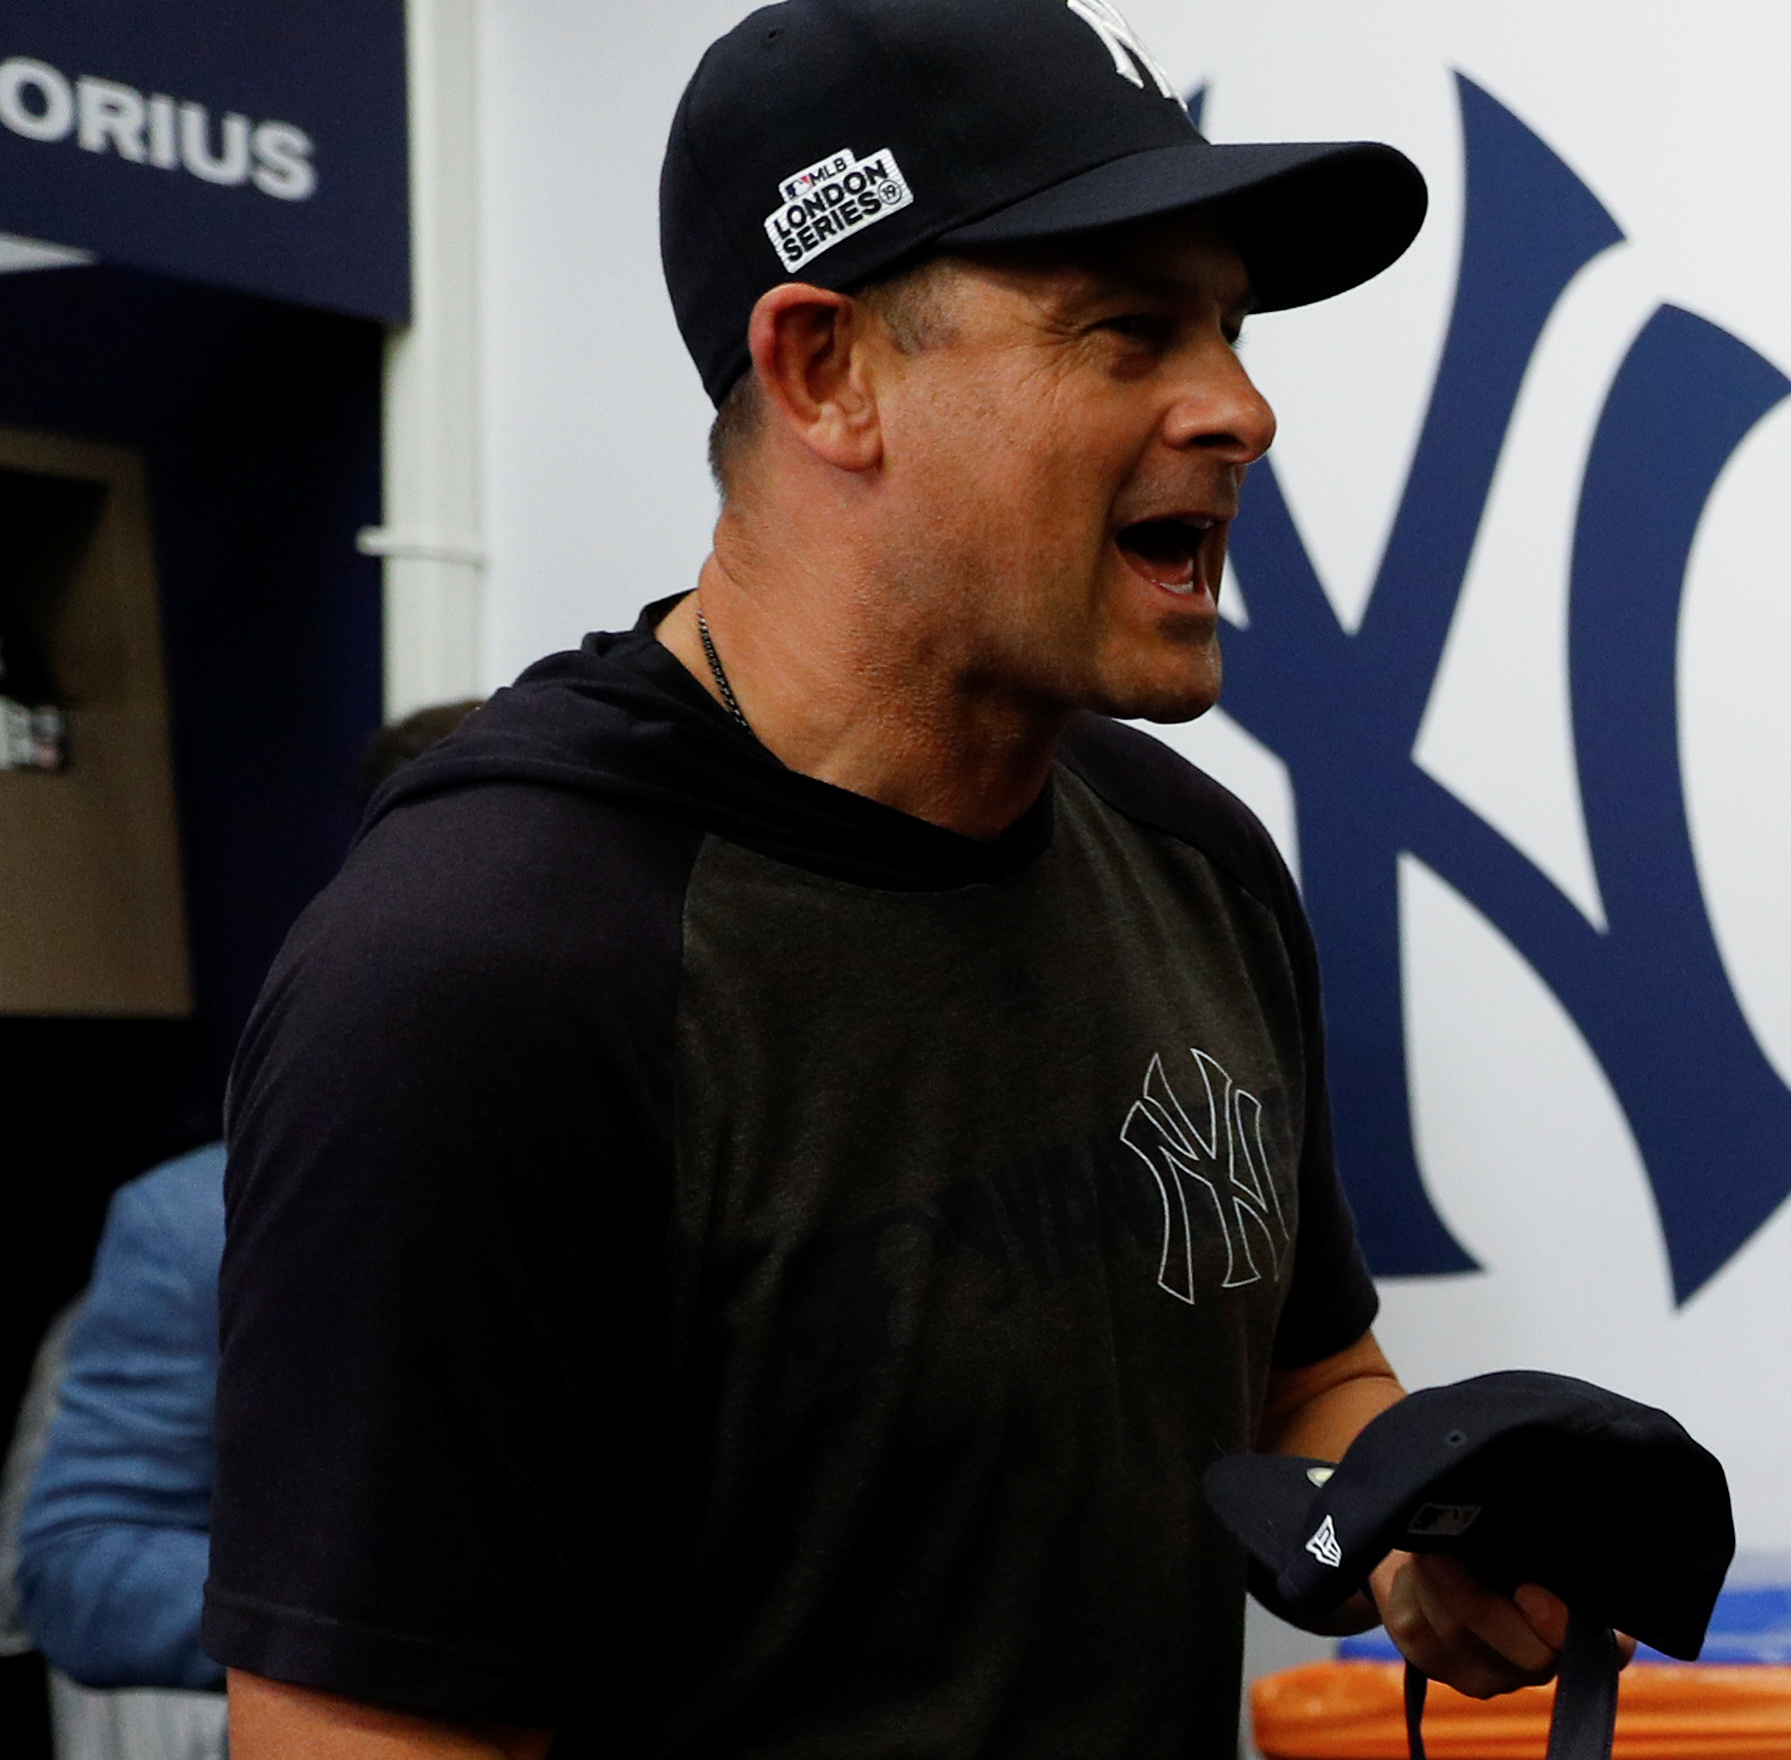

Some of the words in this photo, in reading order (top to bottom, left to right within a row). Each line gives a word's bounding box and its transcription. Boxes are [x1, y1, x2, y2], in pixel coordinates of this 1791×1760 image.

[0, 55, 318, 201] ORIUS
[773, 159, 889, 240] LONDON
[808, 156, 848, 187] MLB
[783, 191, 882, 262] SERIES
[1119, 1047, 1290, 1305] NY
